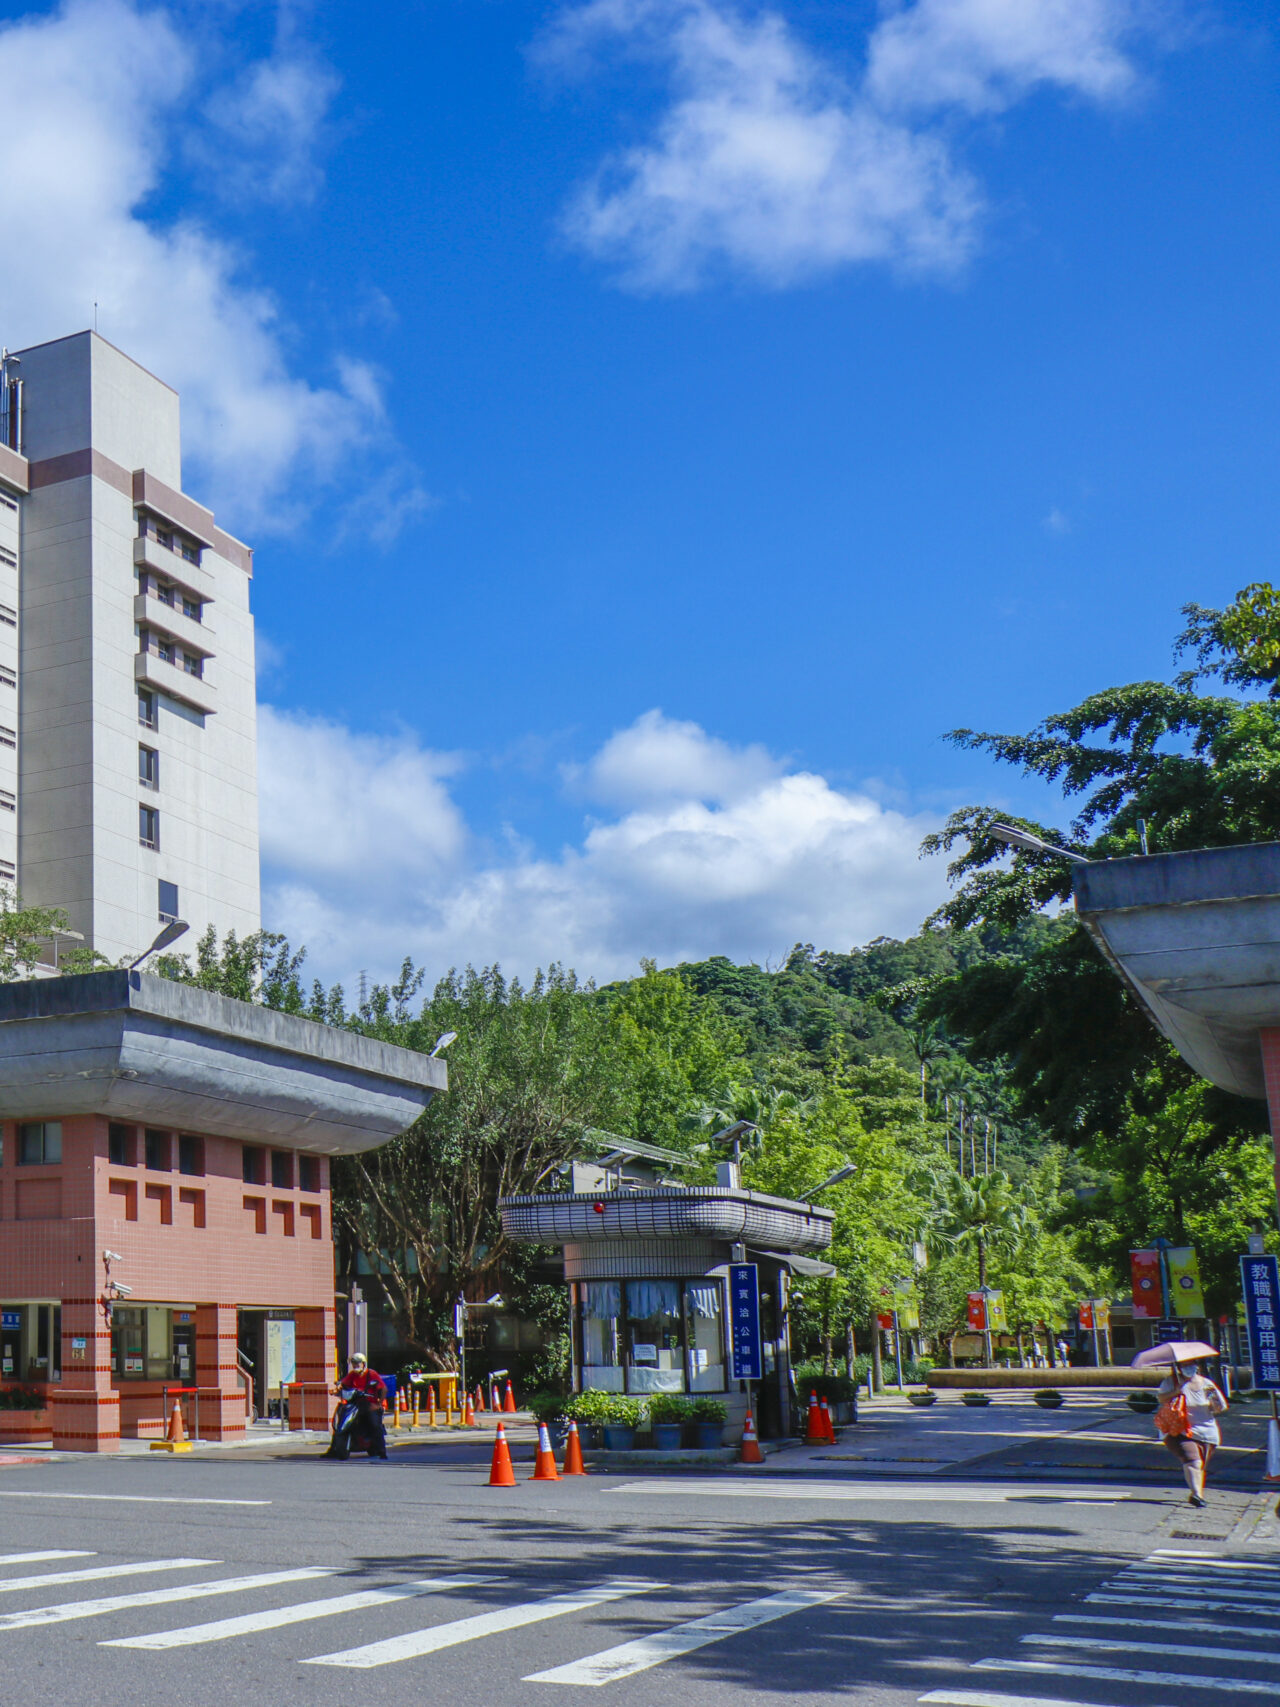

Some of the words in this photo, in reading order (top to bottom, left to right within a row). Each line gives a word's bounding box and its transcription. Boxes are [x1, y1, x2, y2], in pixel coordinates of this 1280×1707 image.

[737, 1270, 752, 1375] 來賓洽公車道
[1251, 1264, 1280, 1382] 教職員專用車道
